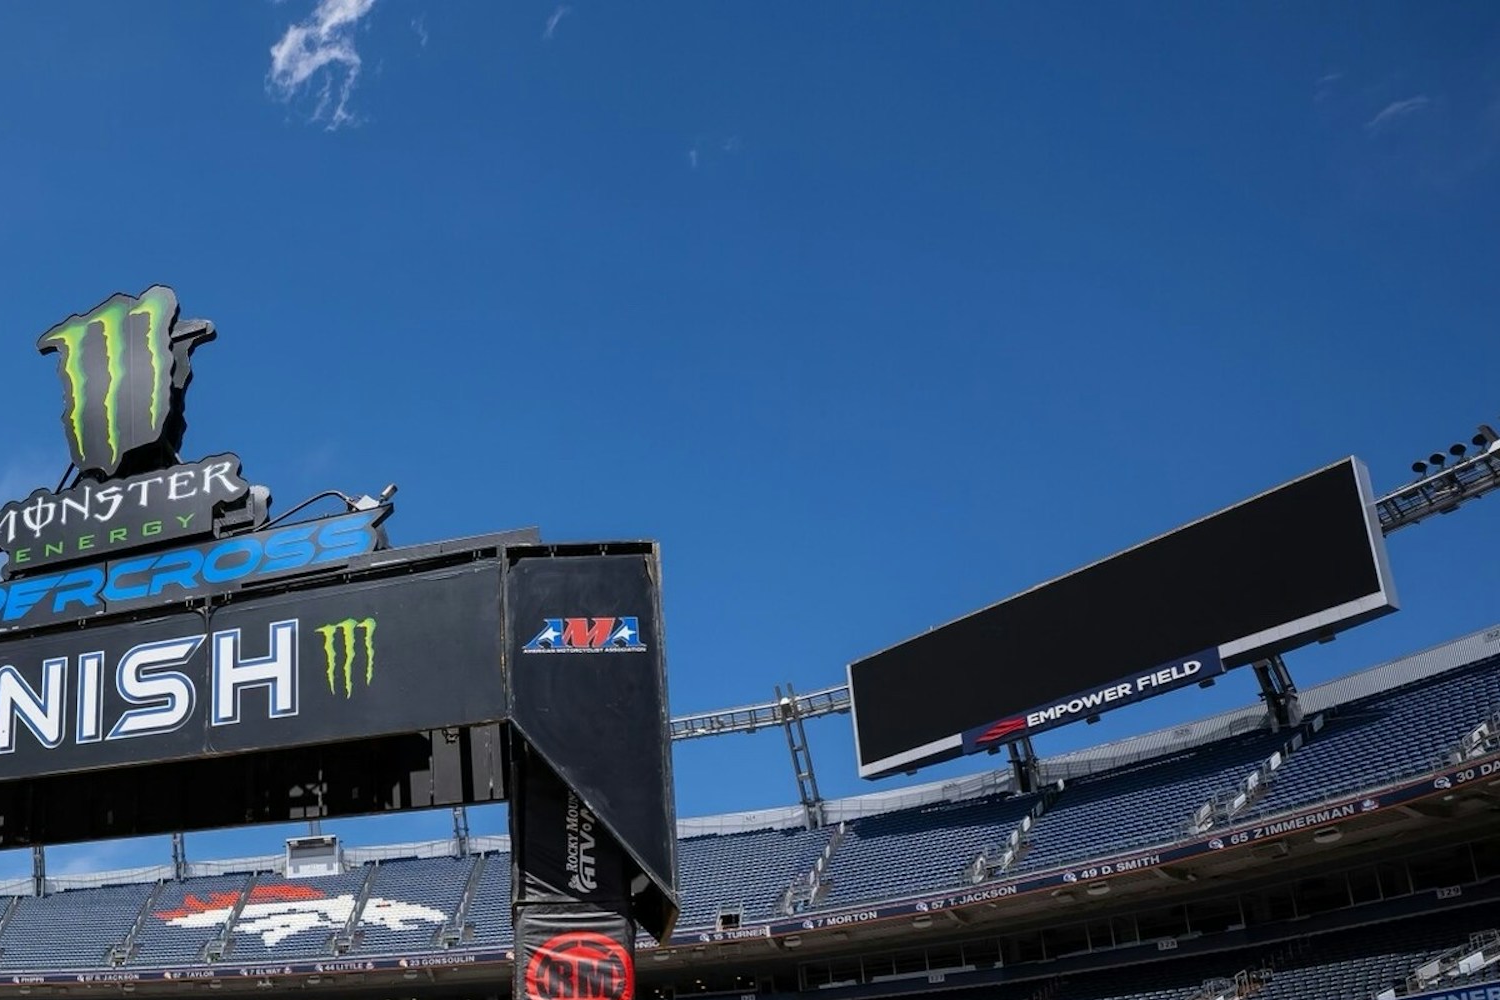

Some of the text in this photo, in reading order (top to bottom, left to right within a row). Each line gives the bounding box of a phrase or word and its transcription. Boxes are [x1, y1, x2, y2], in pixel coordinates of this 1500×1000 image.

[15, 513, 195, 564] ENERGY
[521, 616, 647, 649] AMA
[1027, 660, 1202, 728] EMPOWER FIELD
[1455, 769, 1475, 784] 30
[1230, 804, 1355, 845] 65 ZIMMERMAN
[566, 833, 579, 873] ROCKY
[1080, 854, 1160, 880] 49 D. SMITH
[931, 899, 945, 910] 57
[959, 885, 1017, 905] JACKSON
[817, 911, 878, 927] 7 MORTON
[726, 929, 767, 939] TURNER
[409, 955, 475, 967] 23 GONSOULIN
[103, 973, 140, 981] JACKSON
[186, 970, 215, 978] TAYLOR
[255, 967, 281, 976] ELWAY
